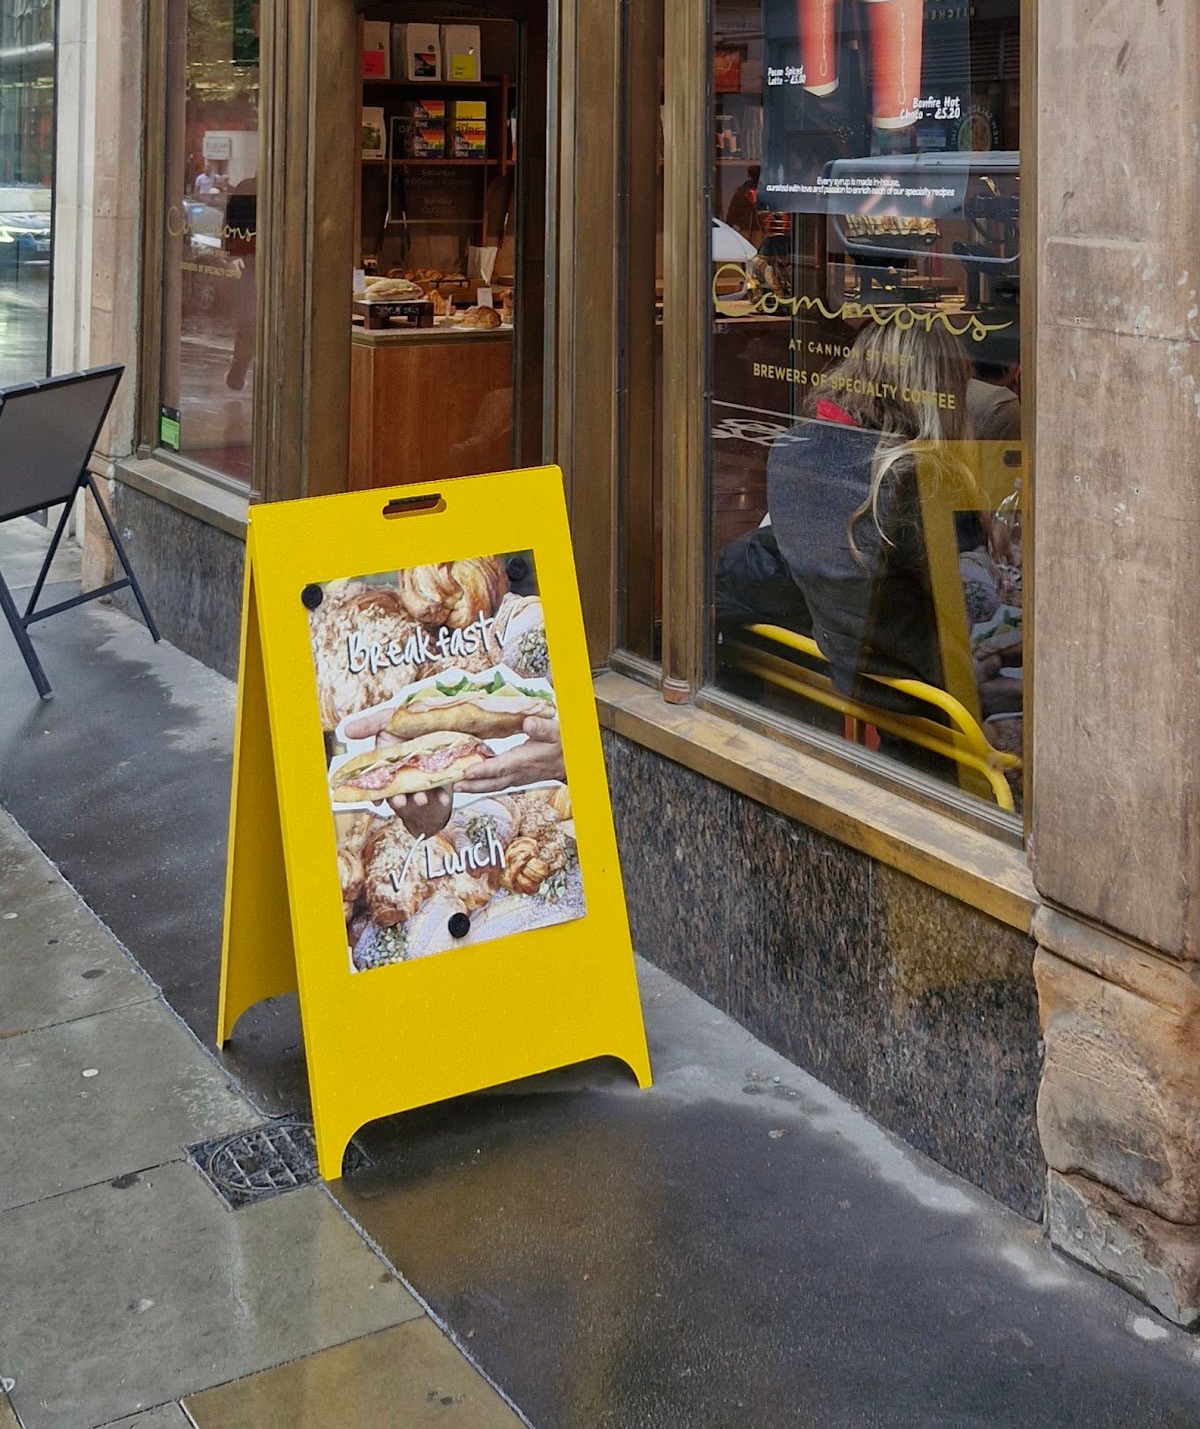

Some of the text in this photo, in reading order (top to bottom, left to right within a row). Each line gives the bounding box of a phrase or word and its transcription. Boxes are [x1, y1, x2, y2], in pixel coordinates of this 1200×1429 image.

[768, 75, 783, 86] Latte
[913, 96, 960, 109] Bonfire Hot
[816, 176, 833, 187] Every
[834, 177, 850, 187] syrup
[856, 177, 872, 186] made
[712, 263, 1013, 342] Commons
[788, 338, 916, 368] AT CANNON STREET
[753, 362, 956, 410] BREWERS OF SPECIALTY COFFEE
[424, 826, 506, 880] Lunch
